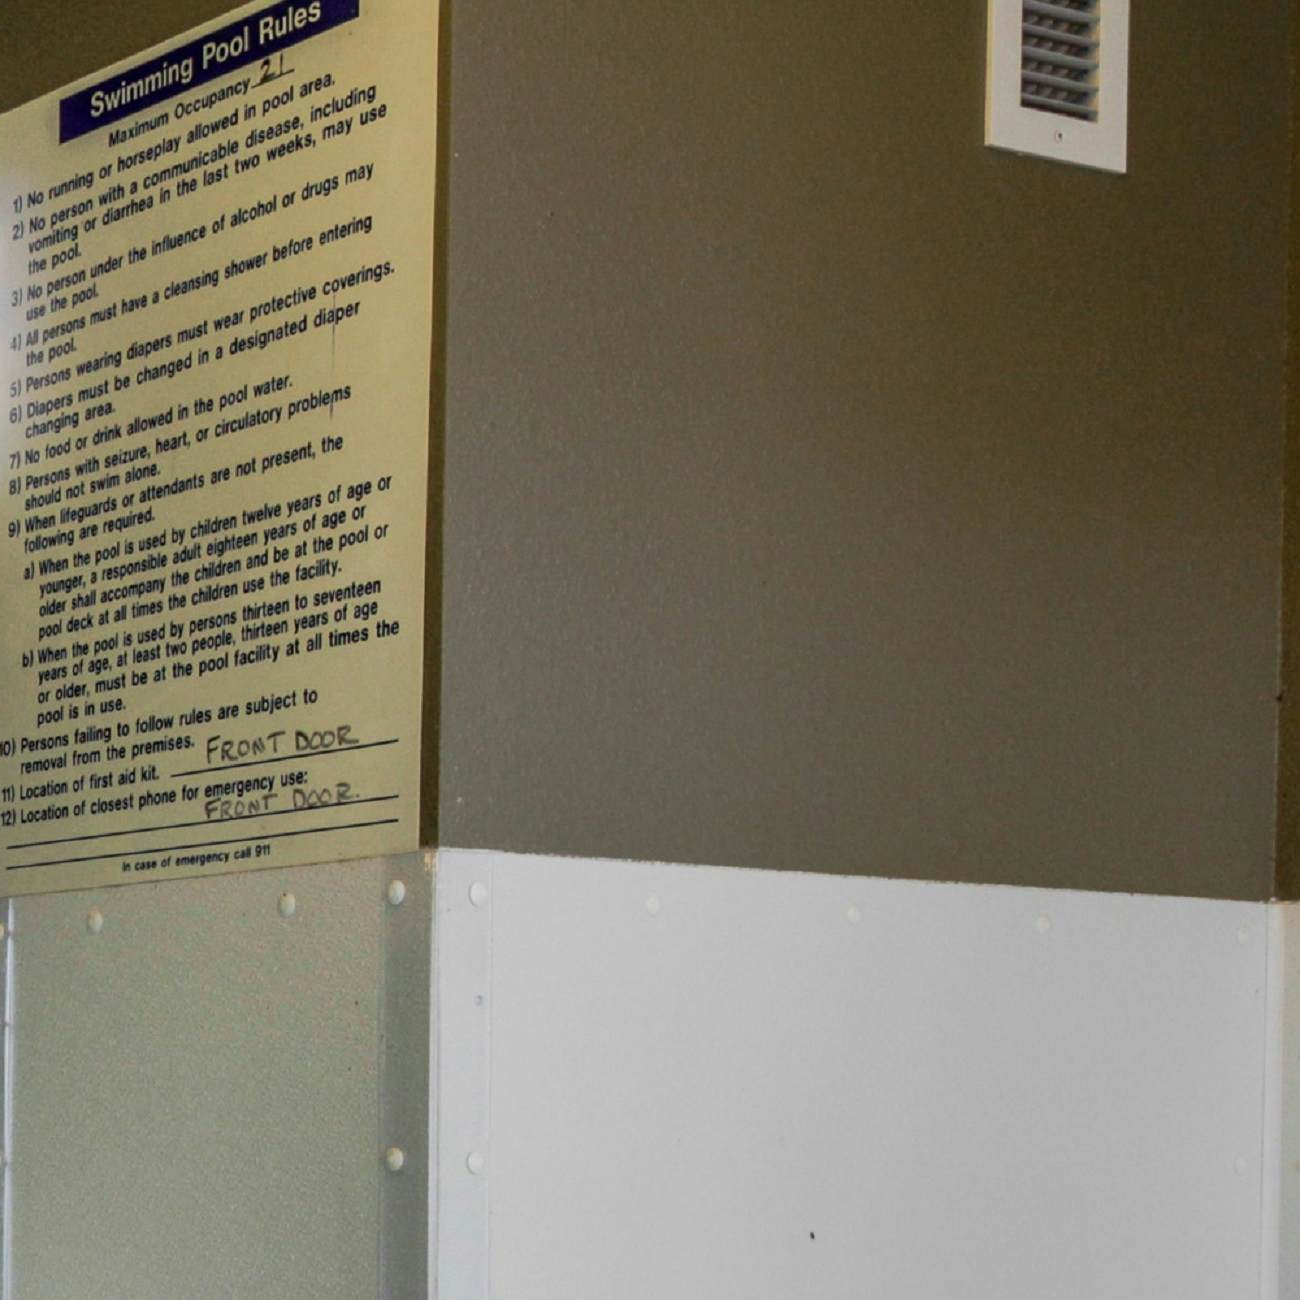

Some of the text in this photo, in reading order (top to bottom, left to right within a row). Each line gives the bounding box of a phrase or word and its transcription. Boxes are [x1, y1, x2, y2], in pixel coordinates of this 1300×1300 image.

[90, 1, 321, 117] Swimming Pool Rules
[48, 73, 335, 200] running horseplay allowed pool area.
[108, 77, 250, 148] Maximum Occupancy
[28, 103, 387, 253] vomiting diarrhea last two weeks, use
[50, 85, 376, 229] person with communicable disease, including
[46, 175, 339, 297] person under influence alcohol drugs
[42, 215, 372, 345] persons must have cleansing shower before entering
[25, 261, 395, 392] Persons wearing diapers must wear protective coverings.
[26, 301, 360, 418] Diapers must changed designated diaper
[25, 401, 115, 439] changing area.
[25, 385, 351, 490] Persons with seizure, heart, circulatory problems
[92, 374, 292, 446] drink allowed pool water.
[24, 463, 160, 511] should swim alone.
[24, 441, 315, 533] When lifeguards attendants are present,
[38, 480, 372, 576] When pool used children twelve years age
[23, 505, 155, 554] following are required.
[38, 524, 368, 618] older shall accompany the children and the pool
[39, 510, 346, 599] younger, responsible adult eighteen years age
[37, 579, 381, 664] When the pool used persons thirteen seventeen
[38, 558, 342, 642] pool deck times the children use the facility.
[38, 601, 378, 686] years age, least people, thirteen years age
[55, 619, 399, 701] older, must the pool facility all times the
[20, 690, 296, 754] Persons failing follow rules are subject
[36, 697, 126, 728] pool use.
[206, 724, 359, 764] FRONT DOOR
[19, 767, 136, 801] Location first aid
[20, 735, 195, 775] removal from the premises.
[20, 775, 275, 824] Location closest phone for emergency
[204, 793, 278, 819] FRONT
[134, 843, 270, 871] case emergency call 911
